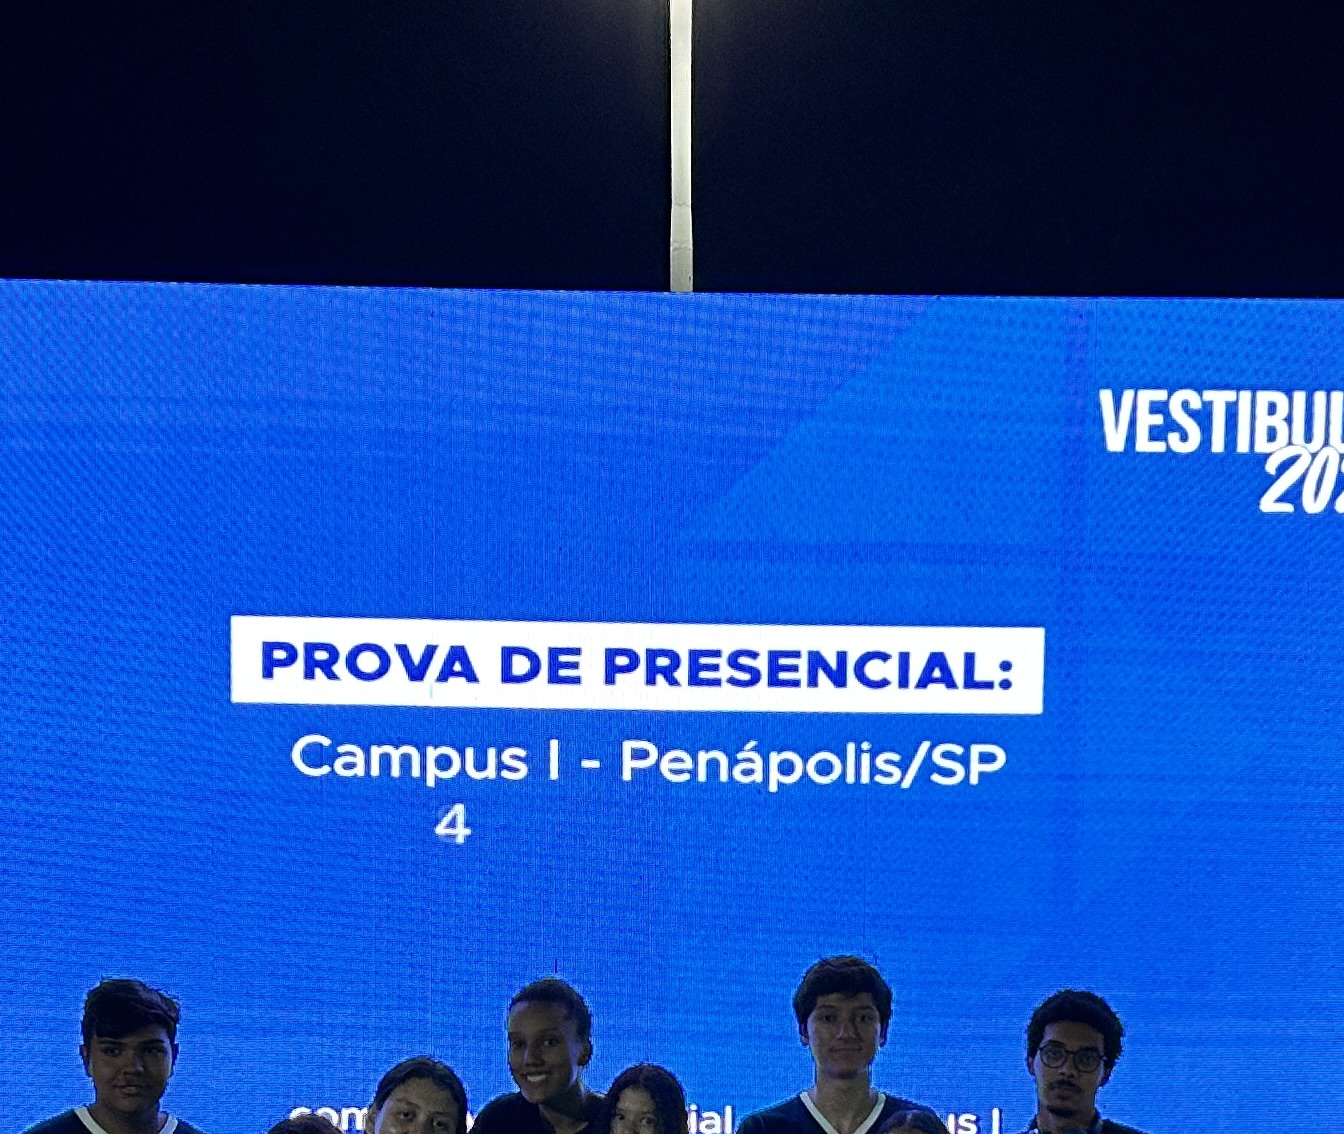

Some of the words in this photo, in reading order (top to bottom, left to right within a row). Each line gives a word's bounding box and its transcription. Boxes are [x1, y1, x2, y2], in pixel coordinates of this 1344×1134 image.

[261, 641, 480, 684] PROVA
[501, 645, 582, 685] DE
[604, 647, 1013, 691] PRESENCIAL:
[291, 734, 528, 788] Campus
[549, 739, 559, 781] I
[622, 739, 1006, 793] Penápolis/SP
[434, 802, 472, 844] 4
